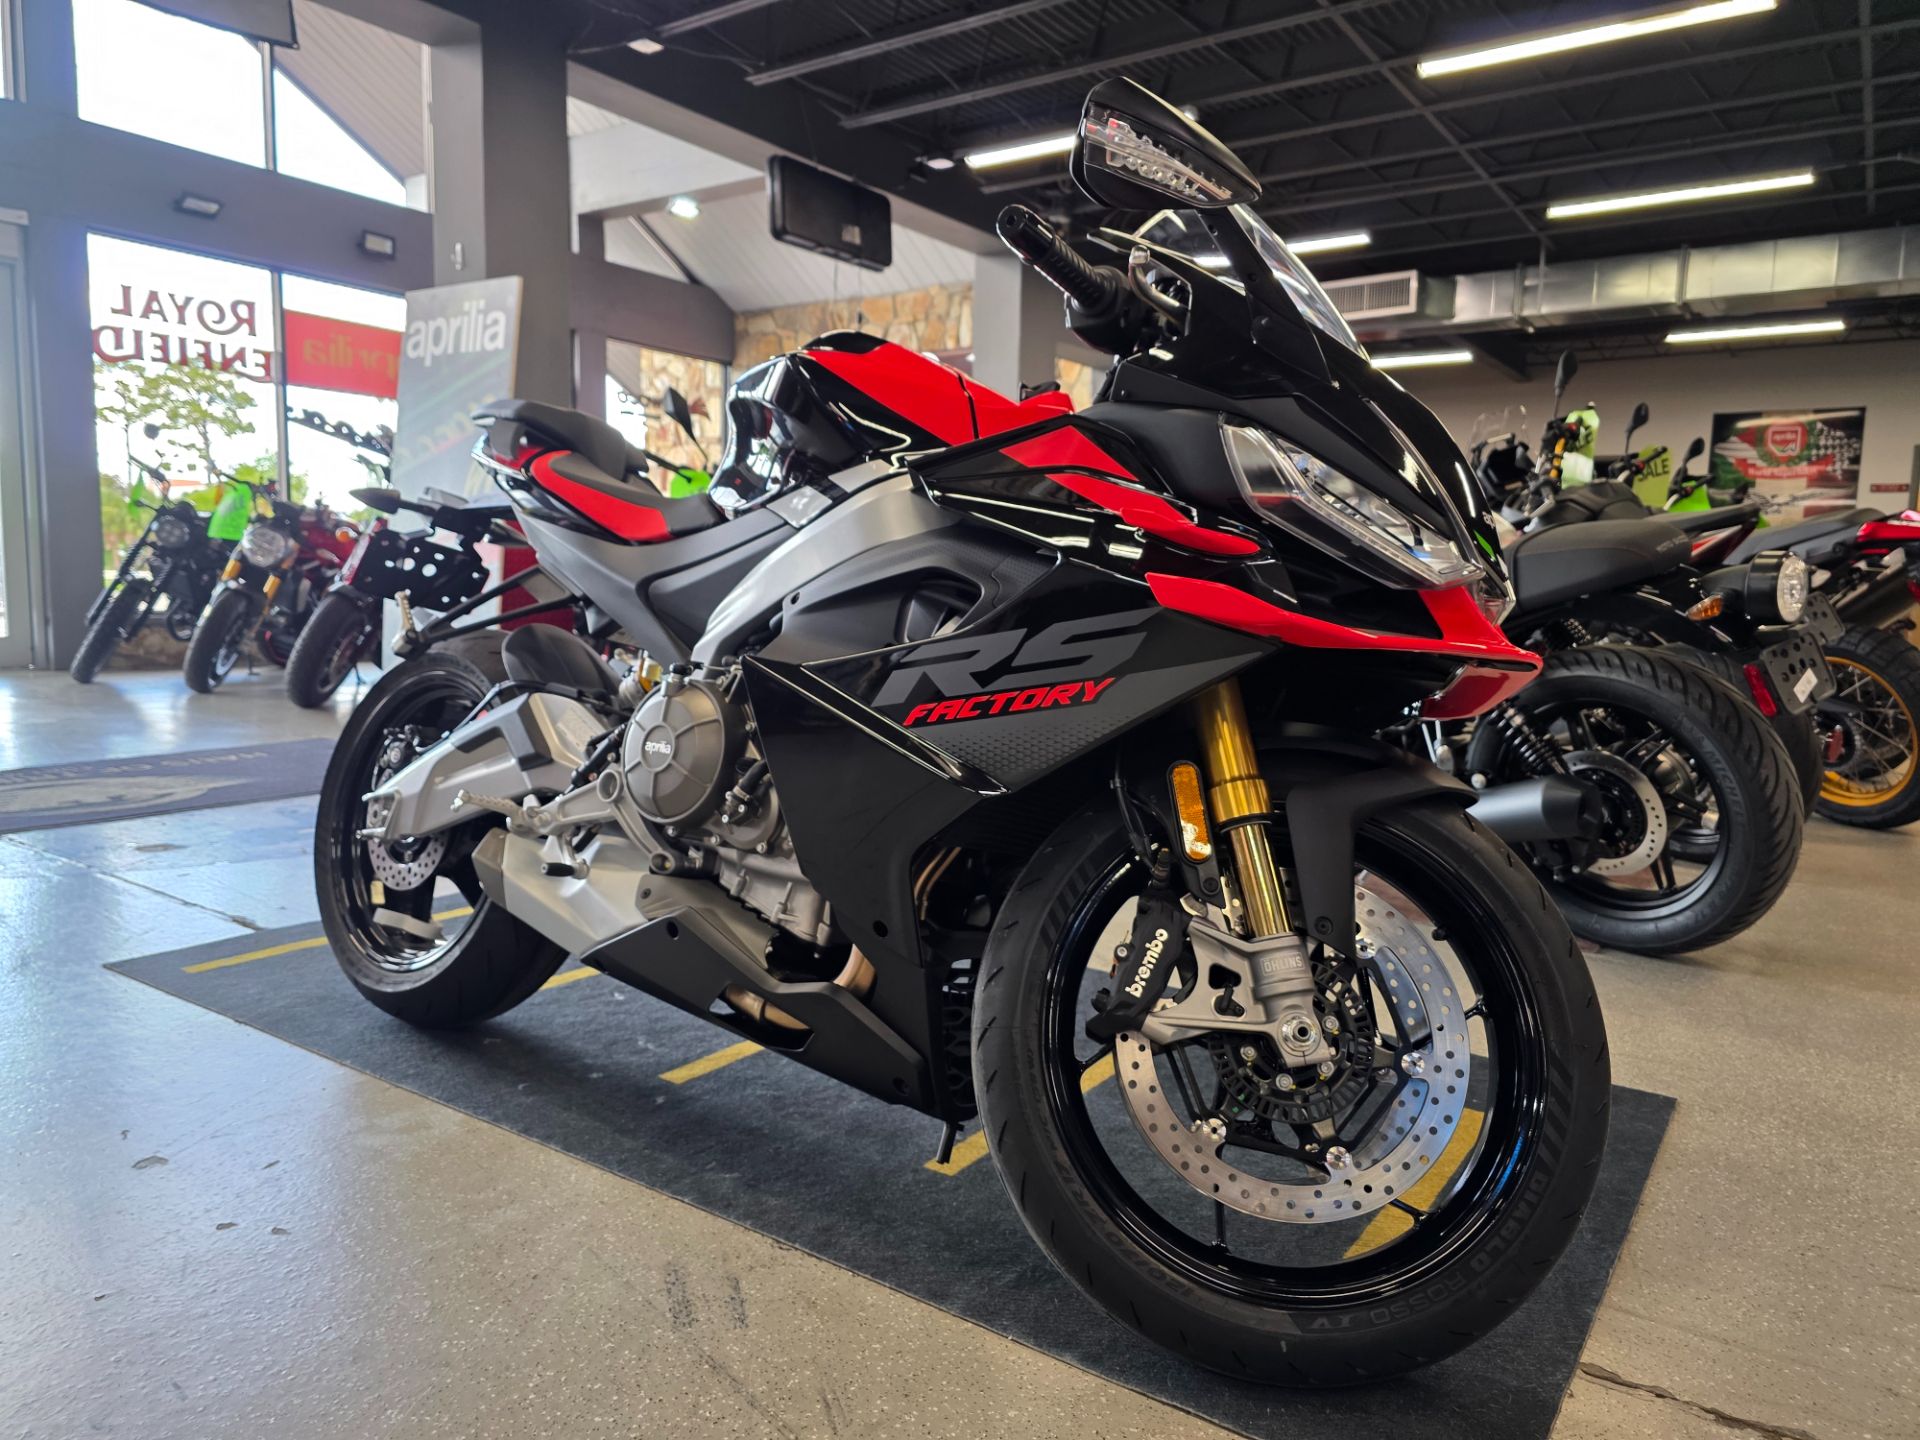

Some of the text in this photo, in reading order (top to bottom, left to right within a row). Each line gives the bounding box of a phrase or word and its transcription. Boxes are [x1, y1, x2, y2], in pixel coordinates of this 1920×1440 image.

[406, 299, 507, 367] aprilia
[871, 605, 1165, 708] RS
[903, 677, 1117, 728] FACTORY
[644, 741, 671, 754] aprilia
[1125, 928, 1169, 998] brembo
